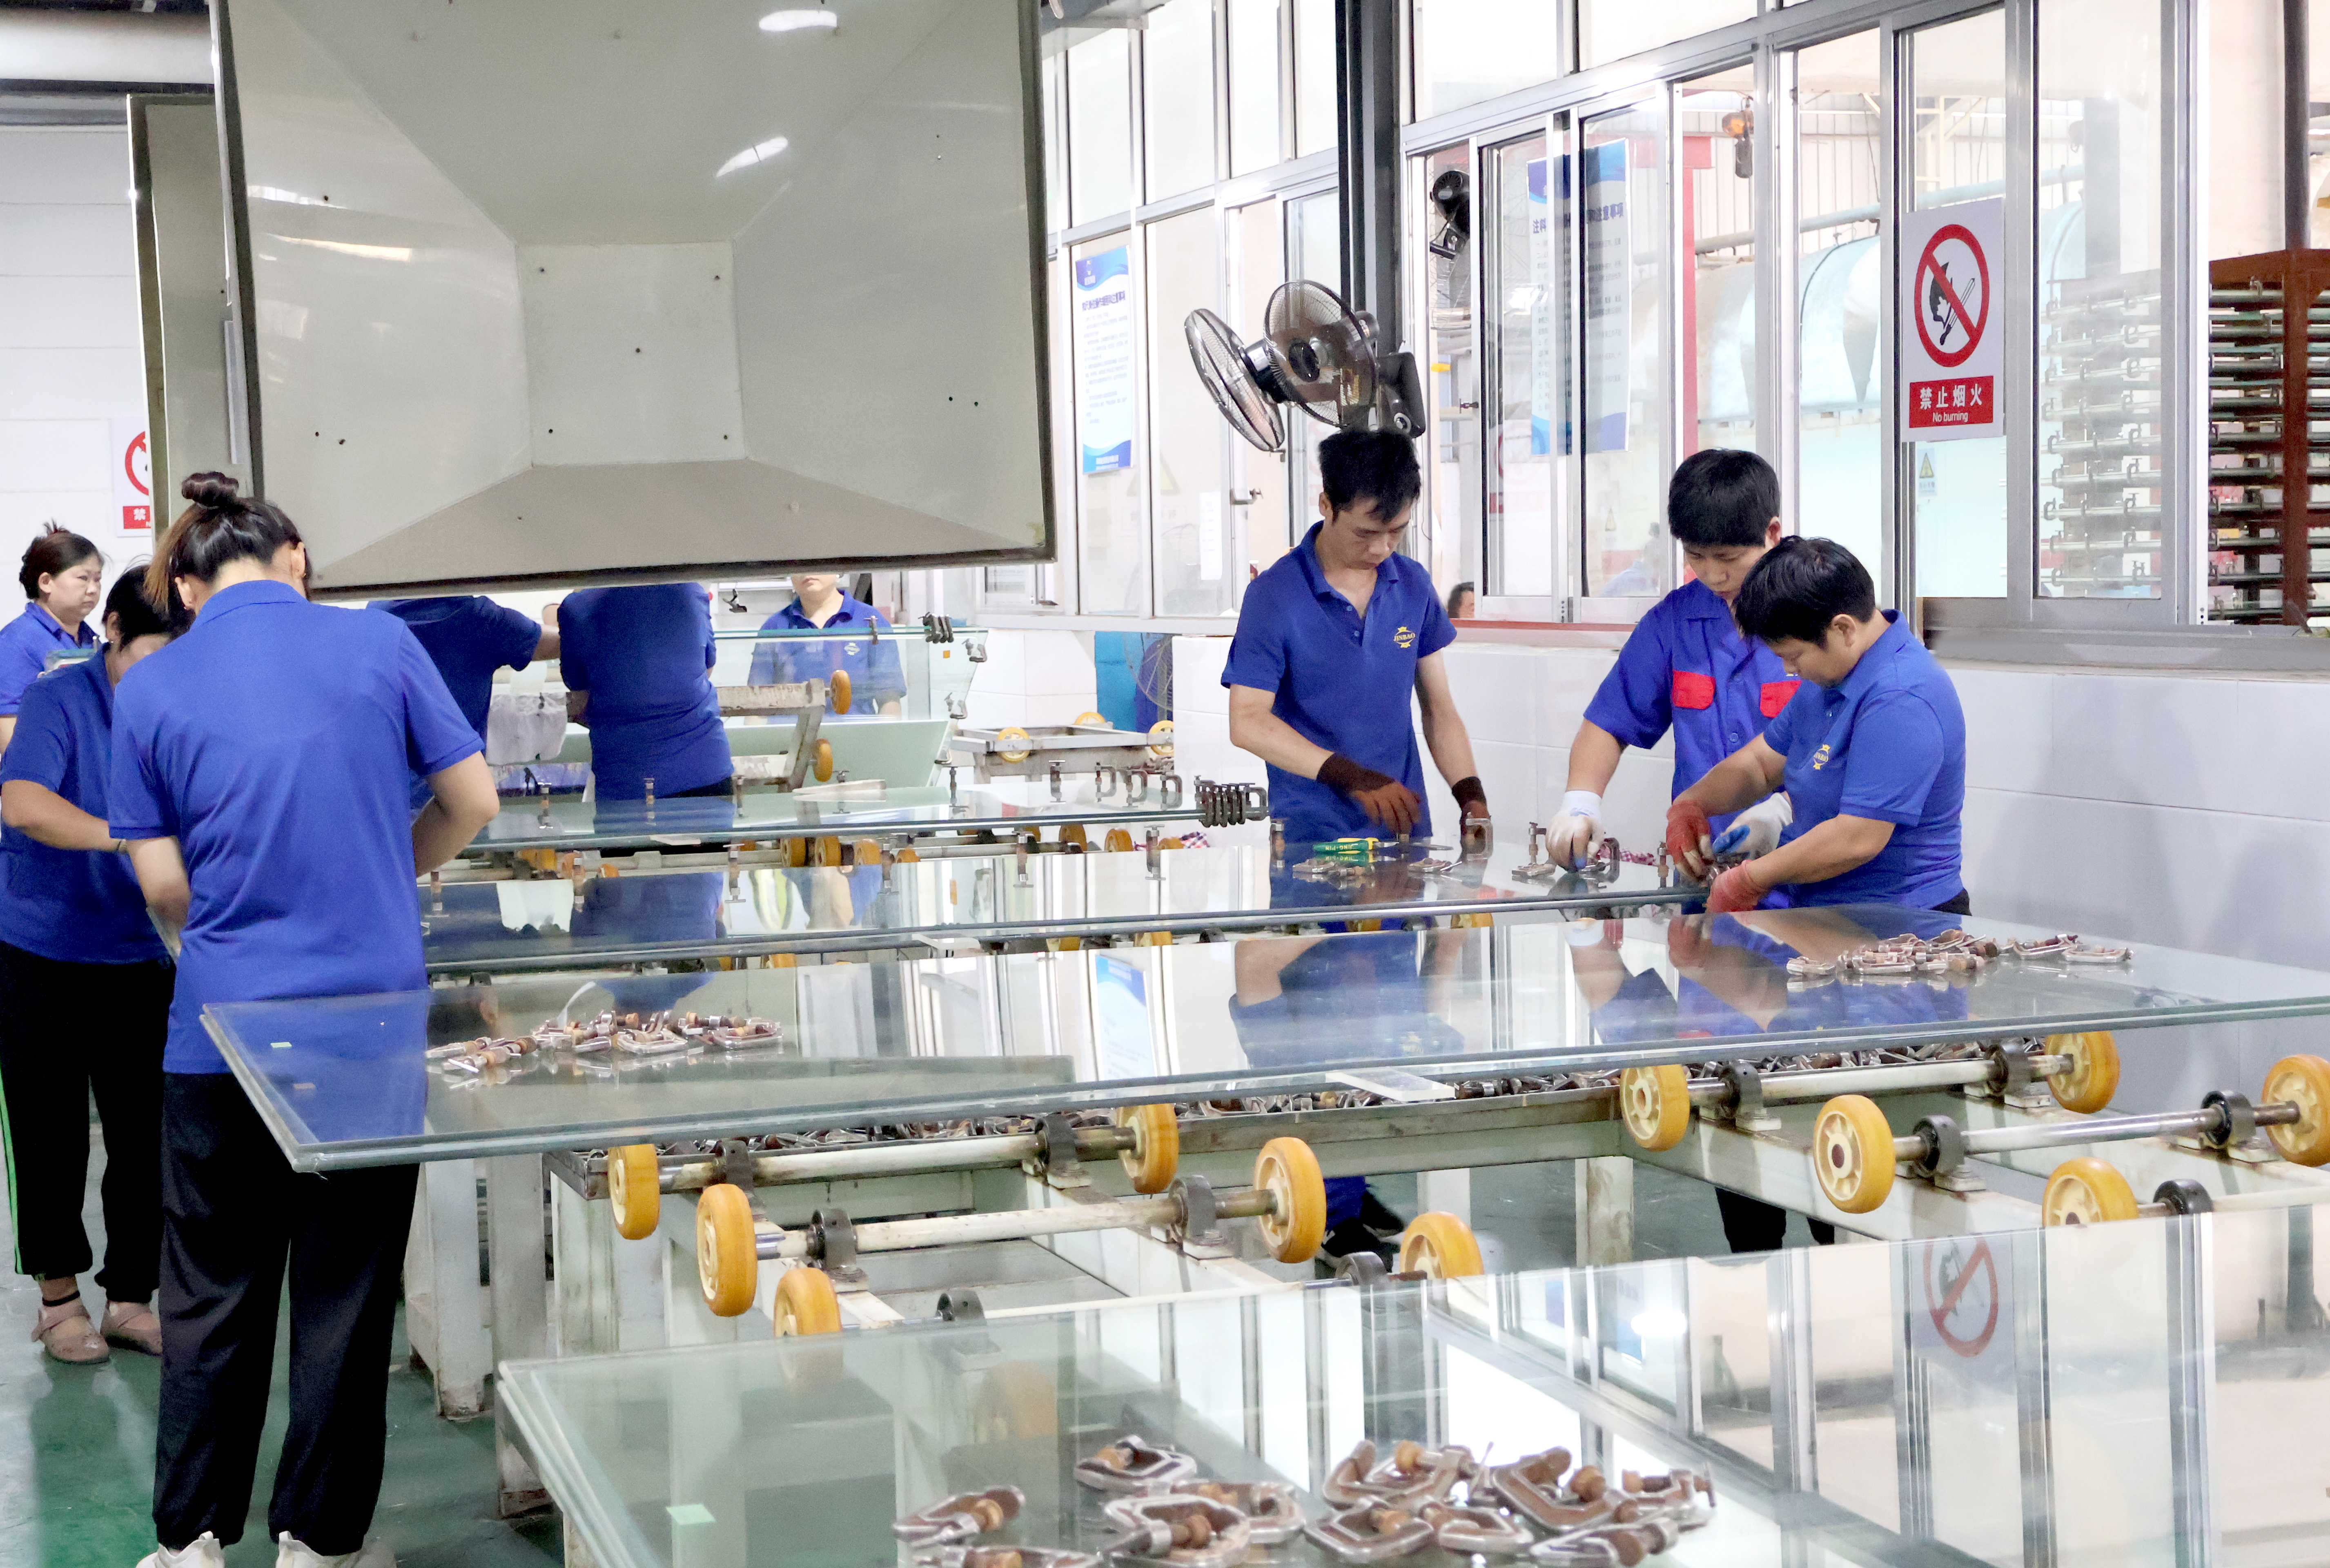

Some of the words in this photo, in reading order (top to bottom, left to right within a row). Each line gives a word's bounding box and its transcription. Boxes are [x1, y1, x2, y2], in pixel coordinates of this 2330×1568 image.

[1920, 383, 1983, 410] 禁止烟火
[1932, 412, 1942, 422] No
[1943, 411, 1969, 423] burning
